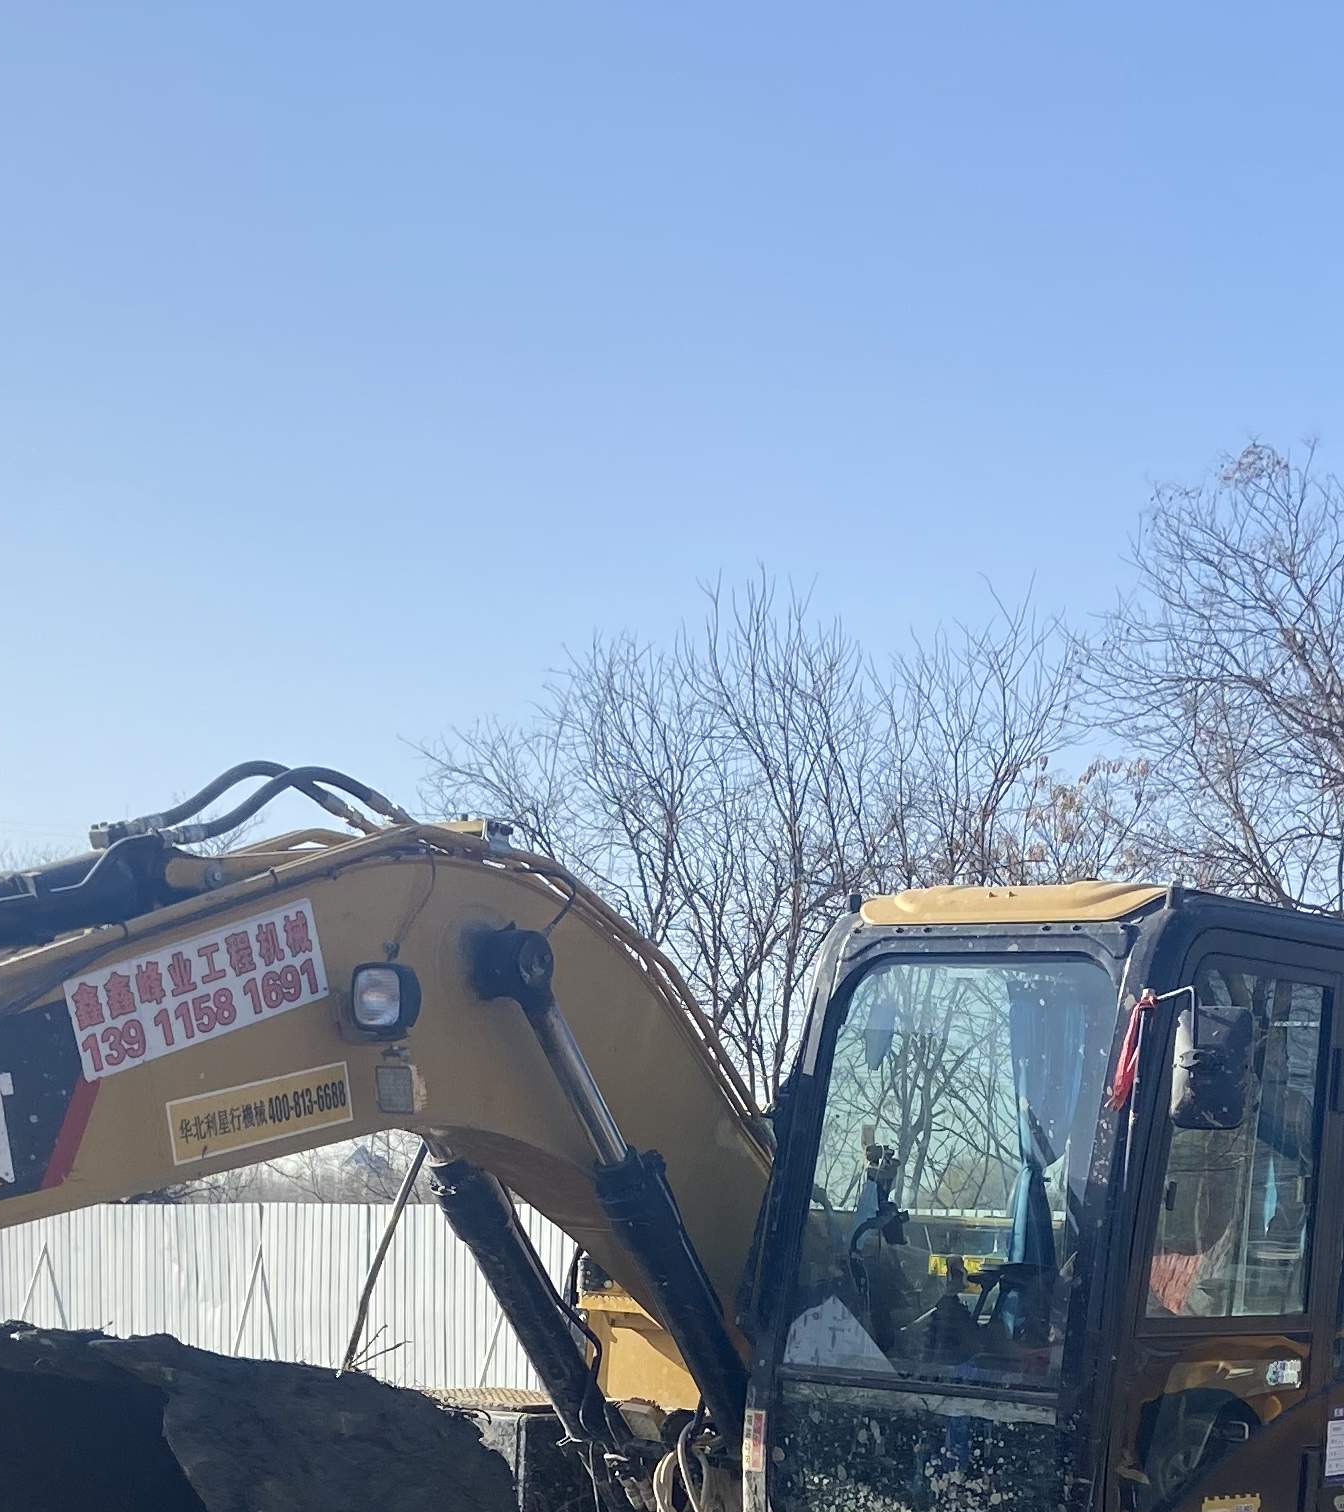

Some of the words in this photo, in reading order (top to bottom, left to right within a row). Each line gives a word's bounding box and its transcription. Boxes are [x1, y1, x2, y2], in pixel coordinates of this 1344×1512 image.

[81, 1018, 146, 1072] 139
[153, 987, 236, 1046] 1158
[243, 958, 319, 1015] 1691
